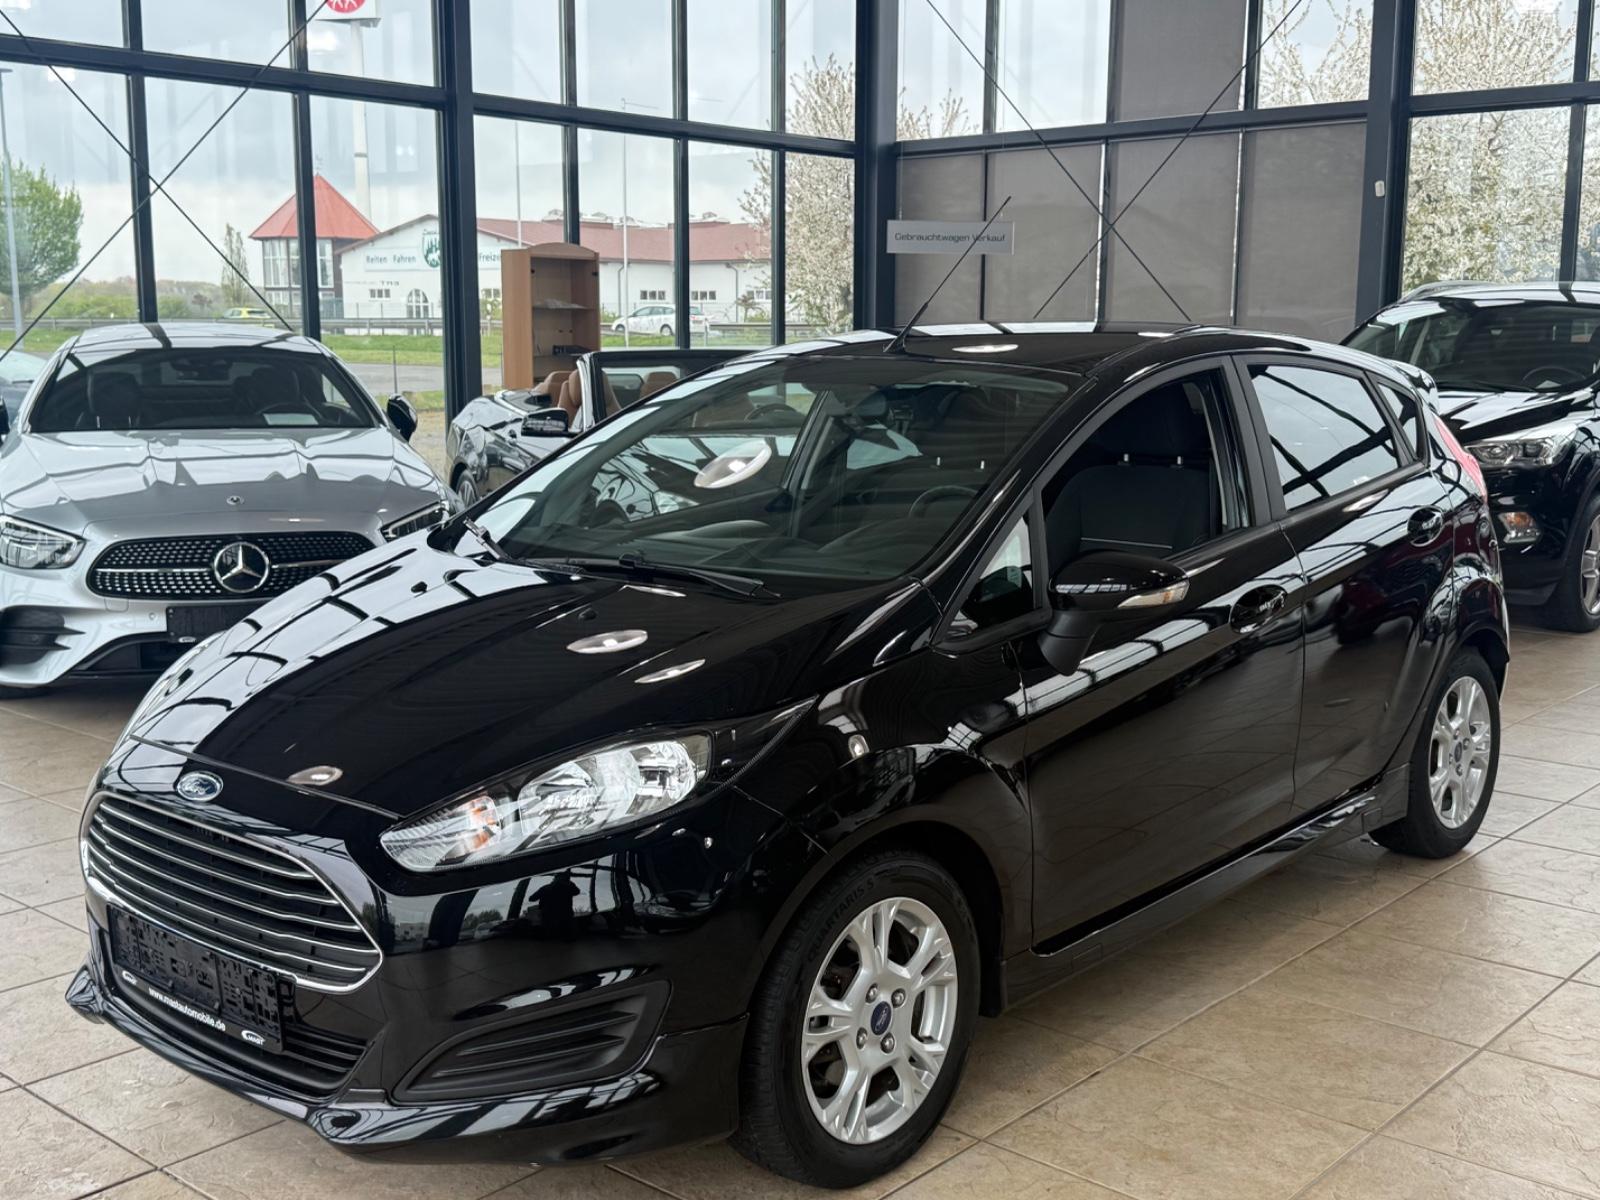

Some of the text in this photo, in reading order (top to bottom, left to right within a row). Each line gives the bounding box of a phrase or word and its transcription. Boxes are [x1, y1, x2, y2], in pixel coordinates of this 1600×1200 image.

[894, 231, 1006, 243] Gebrauchtwagen Verkauf
[393, 253, 416, 264] Fahren
